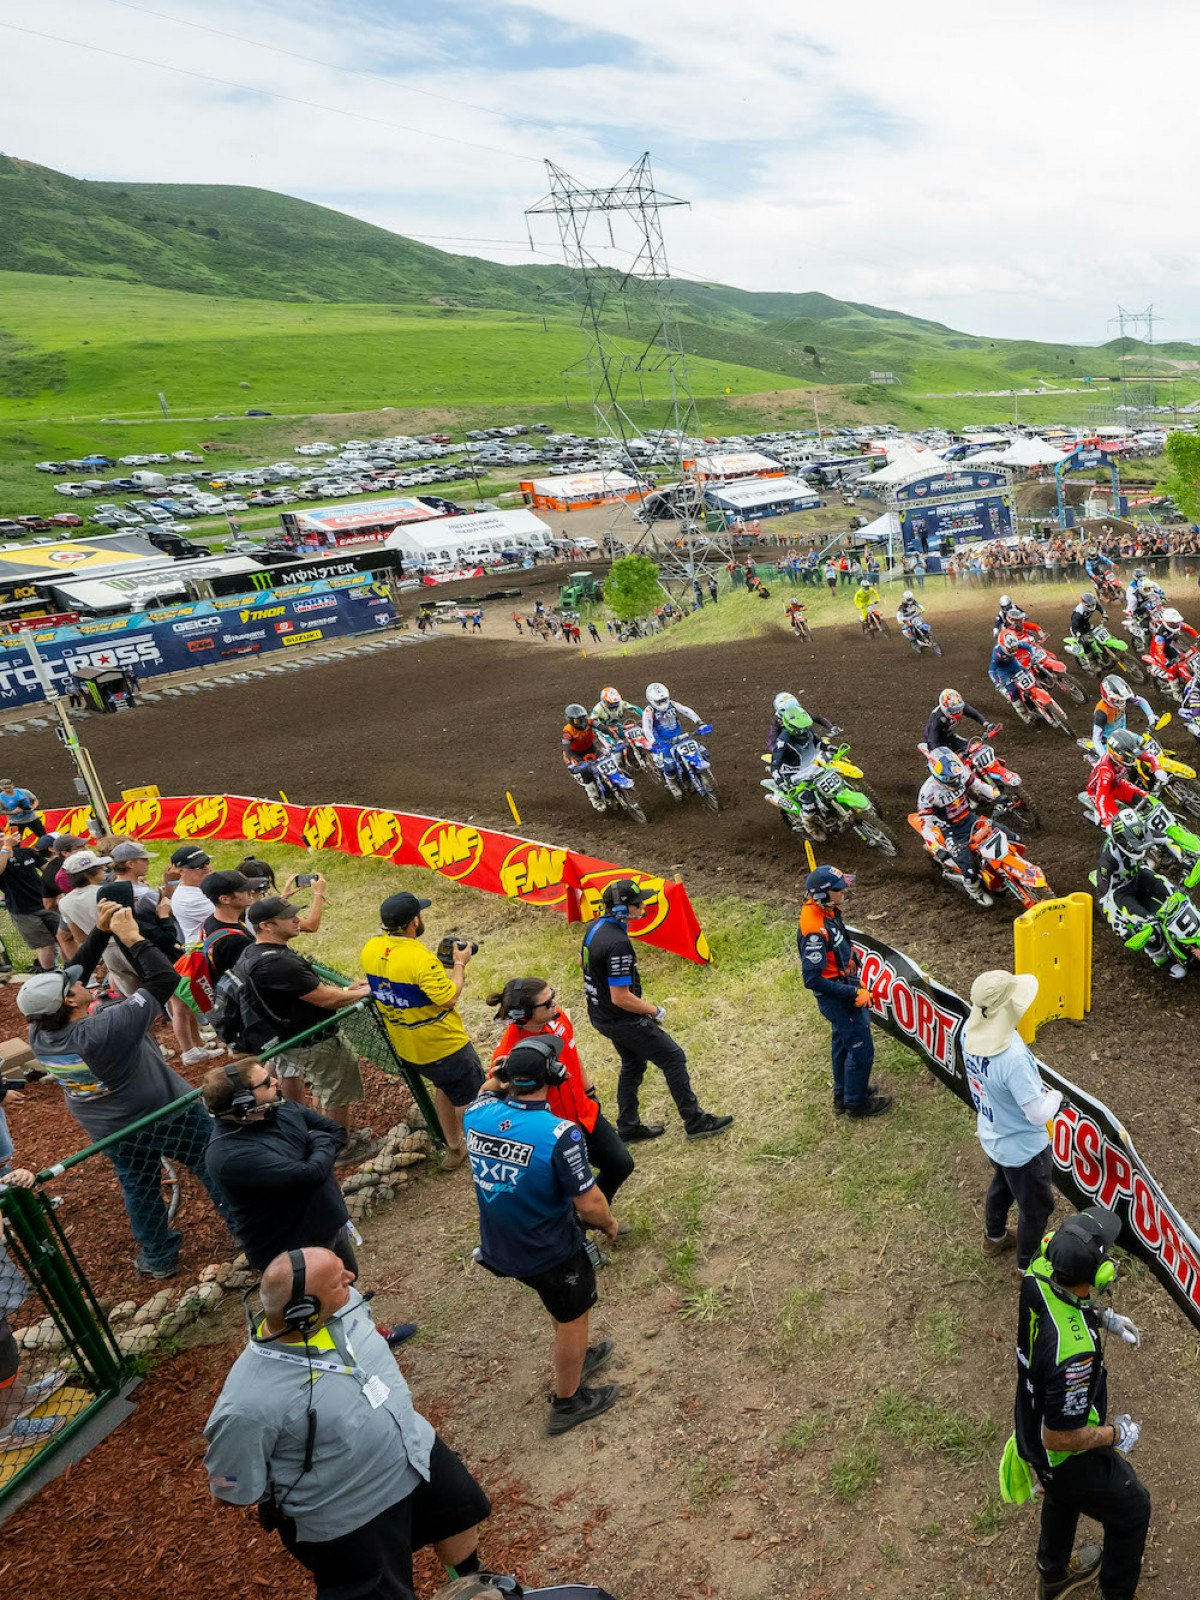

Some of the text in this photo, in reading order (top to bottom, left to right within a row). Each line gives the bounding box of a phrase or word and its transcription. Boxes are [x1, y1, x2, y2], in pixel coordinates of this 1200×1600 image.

[339, 534, 376, 546] GASGAS
[281, 562, 358, 584] MONSTER
[250, 605, 287, 621] THOR
[292, 594, 336, 608] PARTS
[172, 616, 222, 633] GEICO
[285, 632, 320, 644] SUZUKI
[111, 800, 158, 837] FMF
[175, 796, 224, 840] FMF
[243, 803, 285, 840] FMF
[304, 806, 337, 850] FMF
[359, 810, 398, 857] FMF
[420, 824, 479, 870] FMF
[468, 1131, 530, 1164] Muc-Off
[469, 1155, 520, 1186] FXR
[1067, 1315, 1084, 1342] FOX
